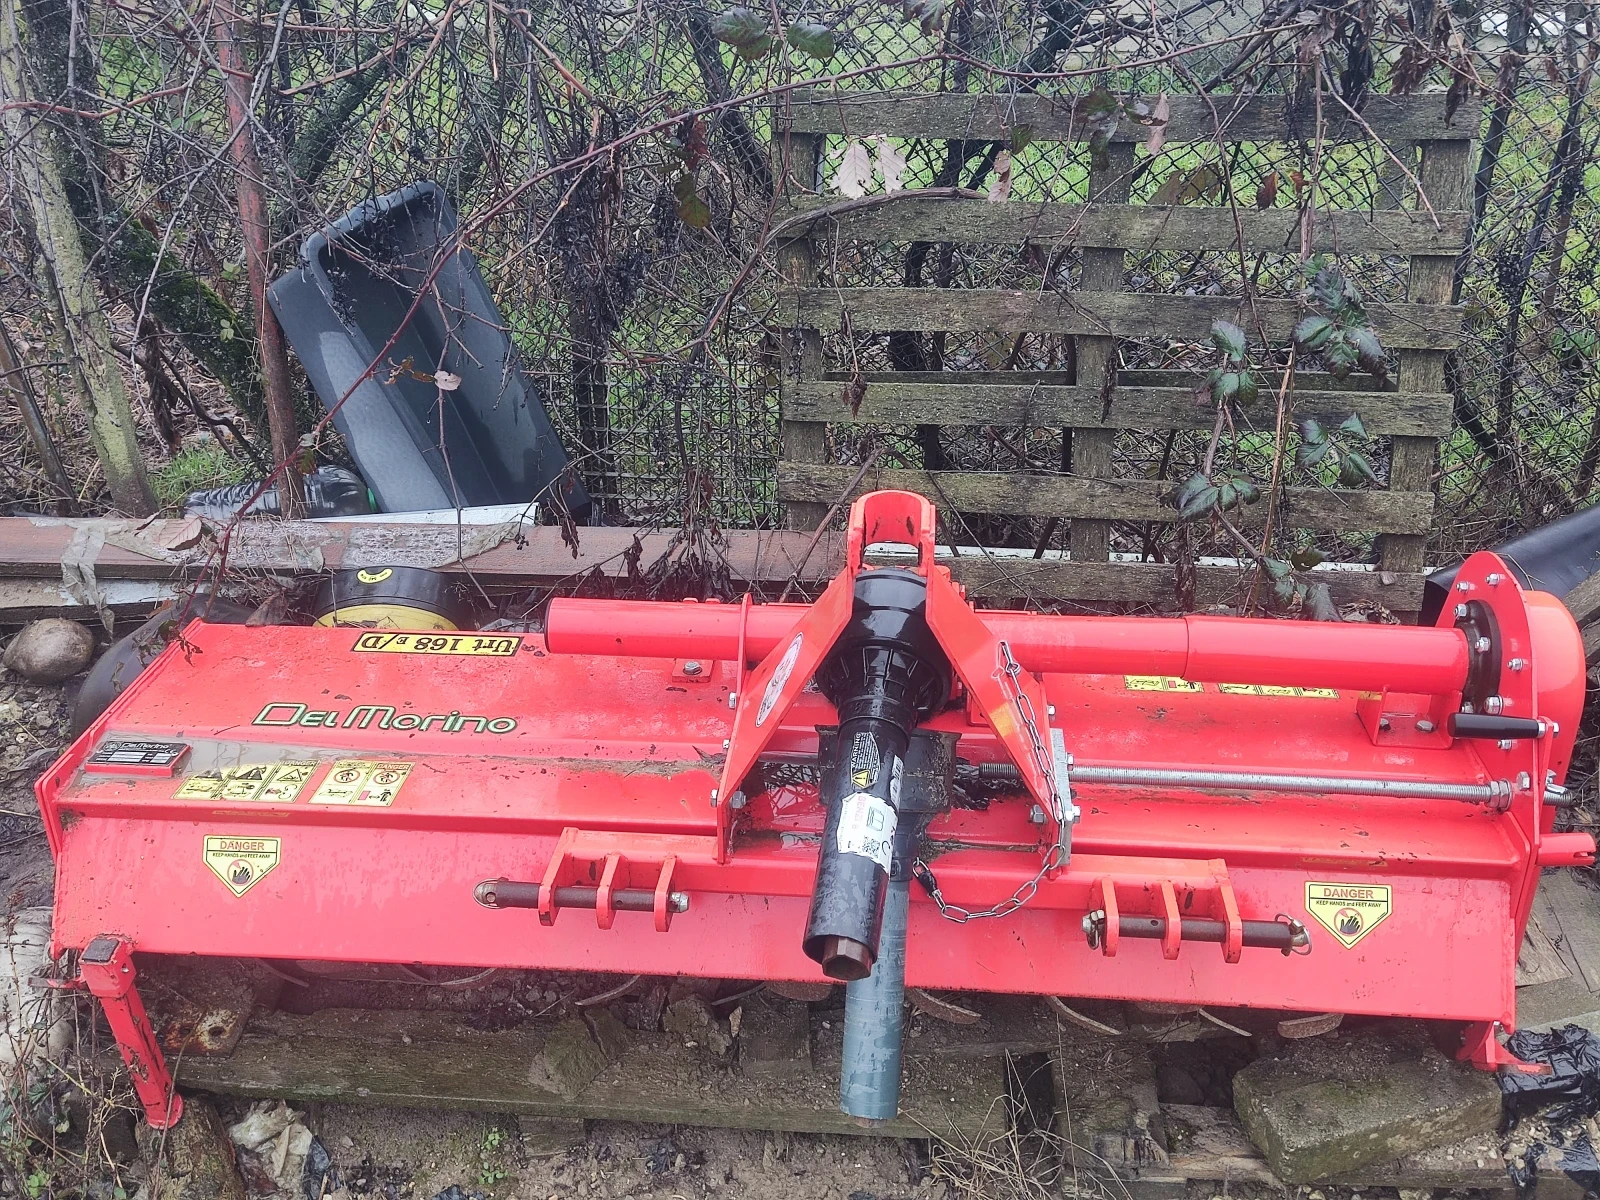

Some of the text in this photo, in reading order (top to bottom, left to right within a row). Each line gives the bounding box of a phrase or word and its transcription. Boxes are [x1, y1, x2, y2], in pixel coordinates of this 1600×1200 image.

[413, 637, 464, 652] 168
[472, 638, 514, 653] Urt
[850, 732, 862, 768] WARNING
[219, 840, 265, 851] DANGER
[1323, 888, 1374, 899] DANGER
